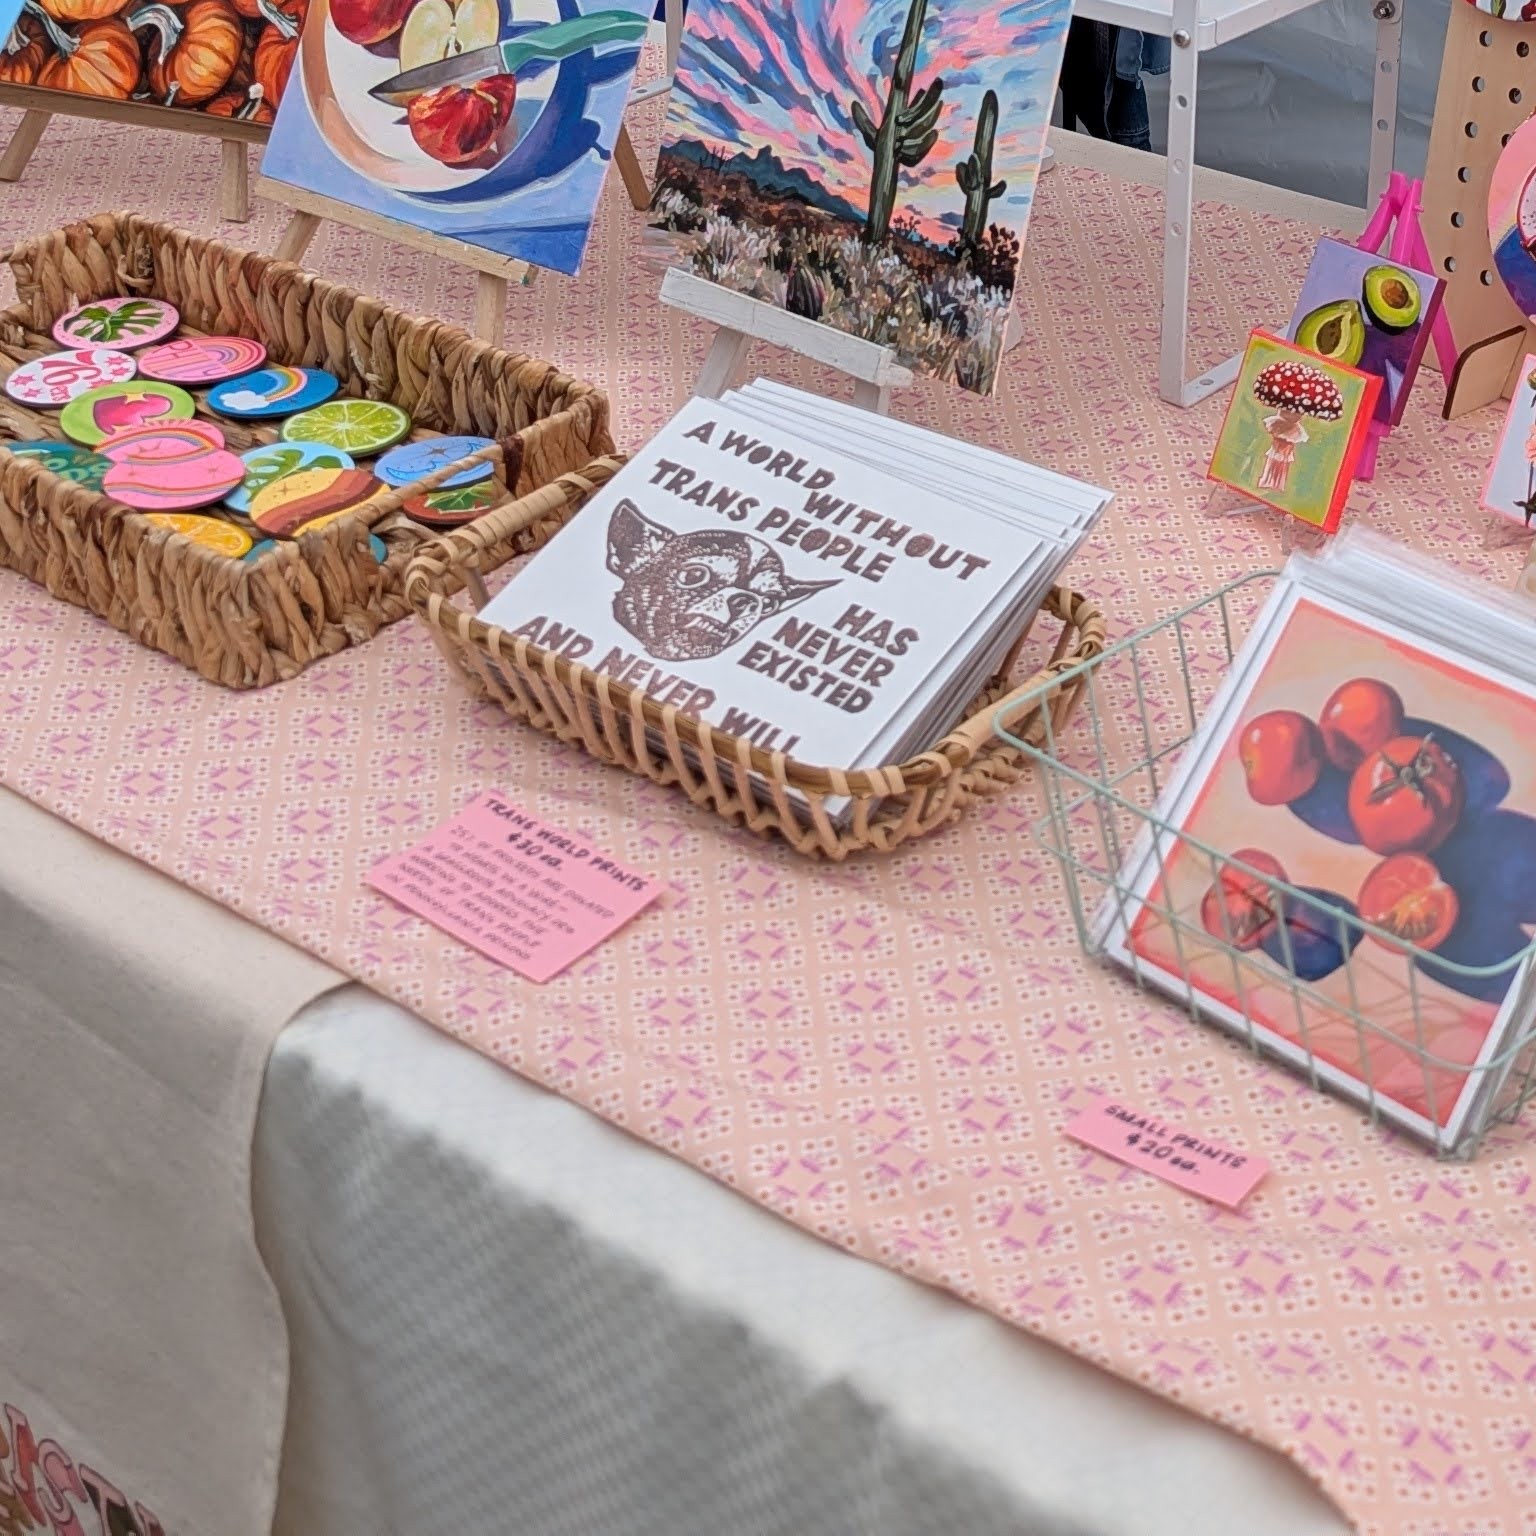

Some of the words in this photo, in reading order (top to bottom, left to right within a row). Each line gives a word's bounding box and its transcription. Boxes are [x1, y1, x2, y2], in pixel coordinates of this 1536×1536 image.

[648, 458, 760, 522] TRANS
[755, 506, 896, 583] PEOPLE
[682, 420, 717, 445] A
[719, 429, 836, 490] WORLD
[802, 491, 991, 580] WITHOUT
[772, 616, 895, 687] NEVER
[832, 603, 919, 656] HAS
[512, 615, 594, 660] AND
[593, 645, 717, 721] NEVER
[736, 640, 873, 714] EXISTED
[485, 798, 537, 830] TRANS
[535, 828, 590, 858] WORLD
[588, 856, 648, 891] PRINTS
[507, 831, 543, 856] $30
[1105, 1105, 1168, 1137] SMALL
[1170, 1133, 1247, 1168] PRINTS
